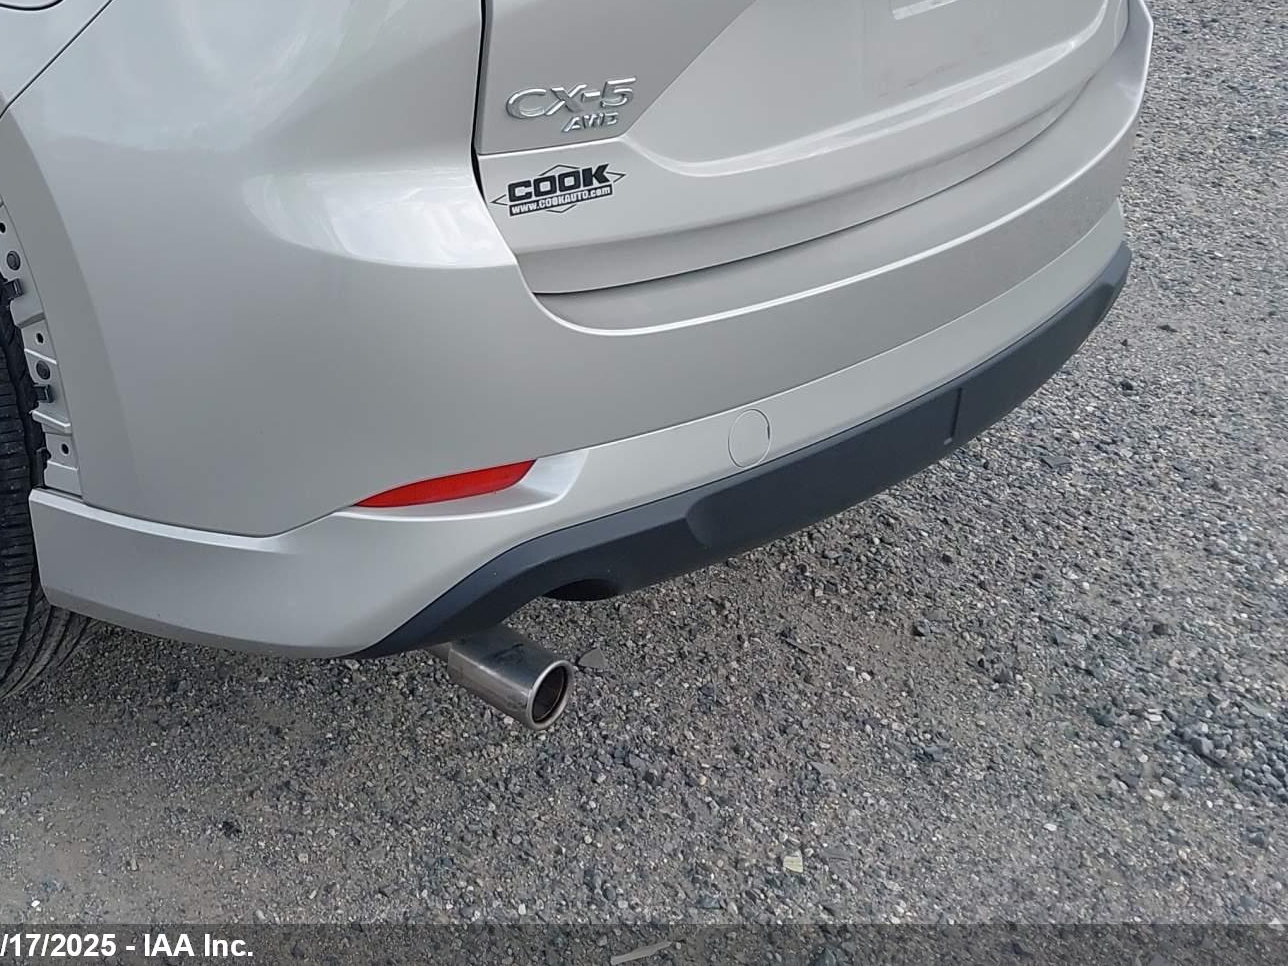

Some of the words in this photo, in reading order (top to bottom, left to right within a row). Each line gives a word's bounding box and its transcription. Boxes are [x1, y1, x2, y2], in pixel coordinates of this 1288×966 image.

[506, 77, 636, 119] CX-5
[561, 112, 619, 133] AWD
[508, 163, 611, 203] COOK
